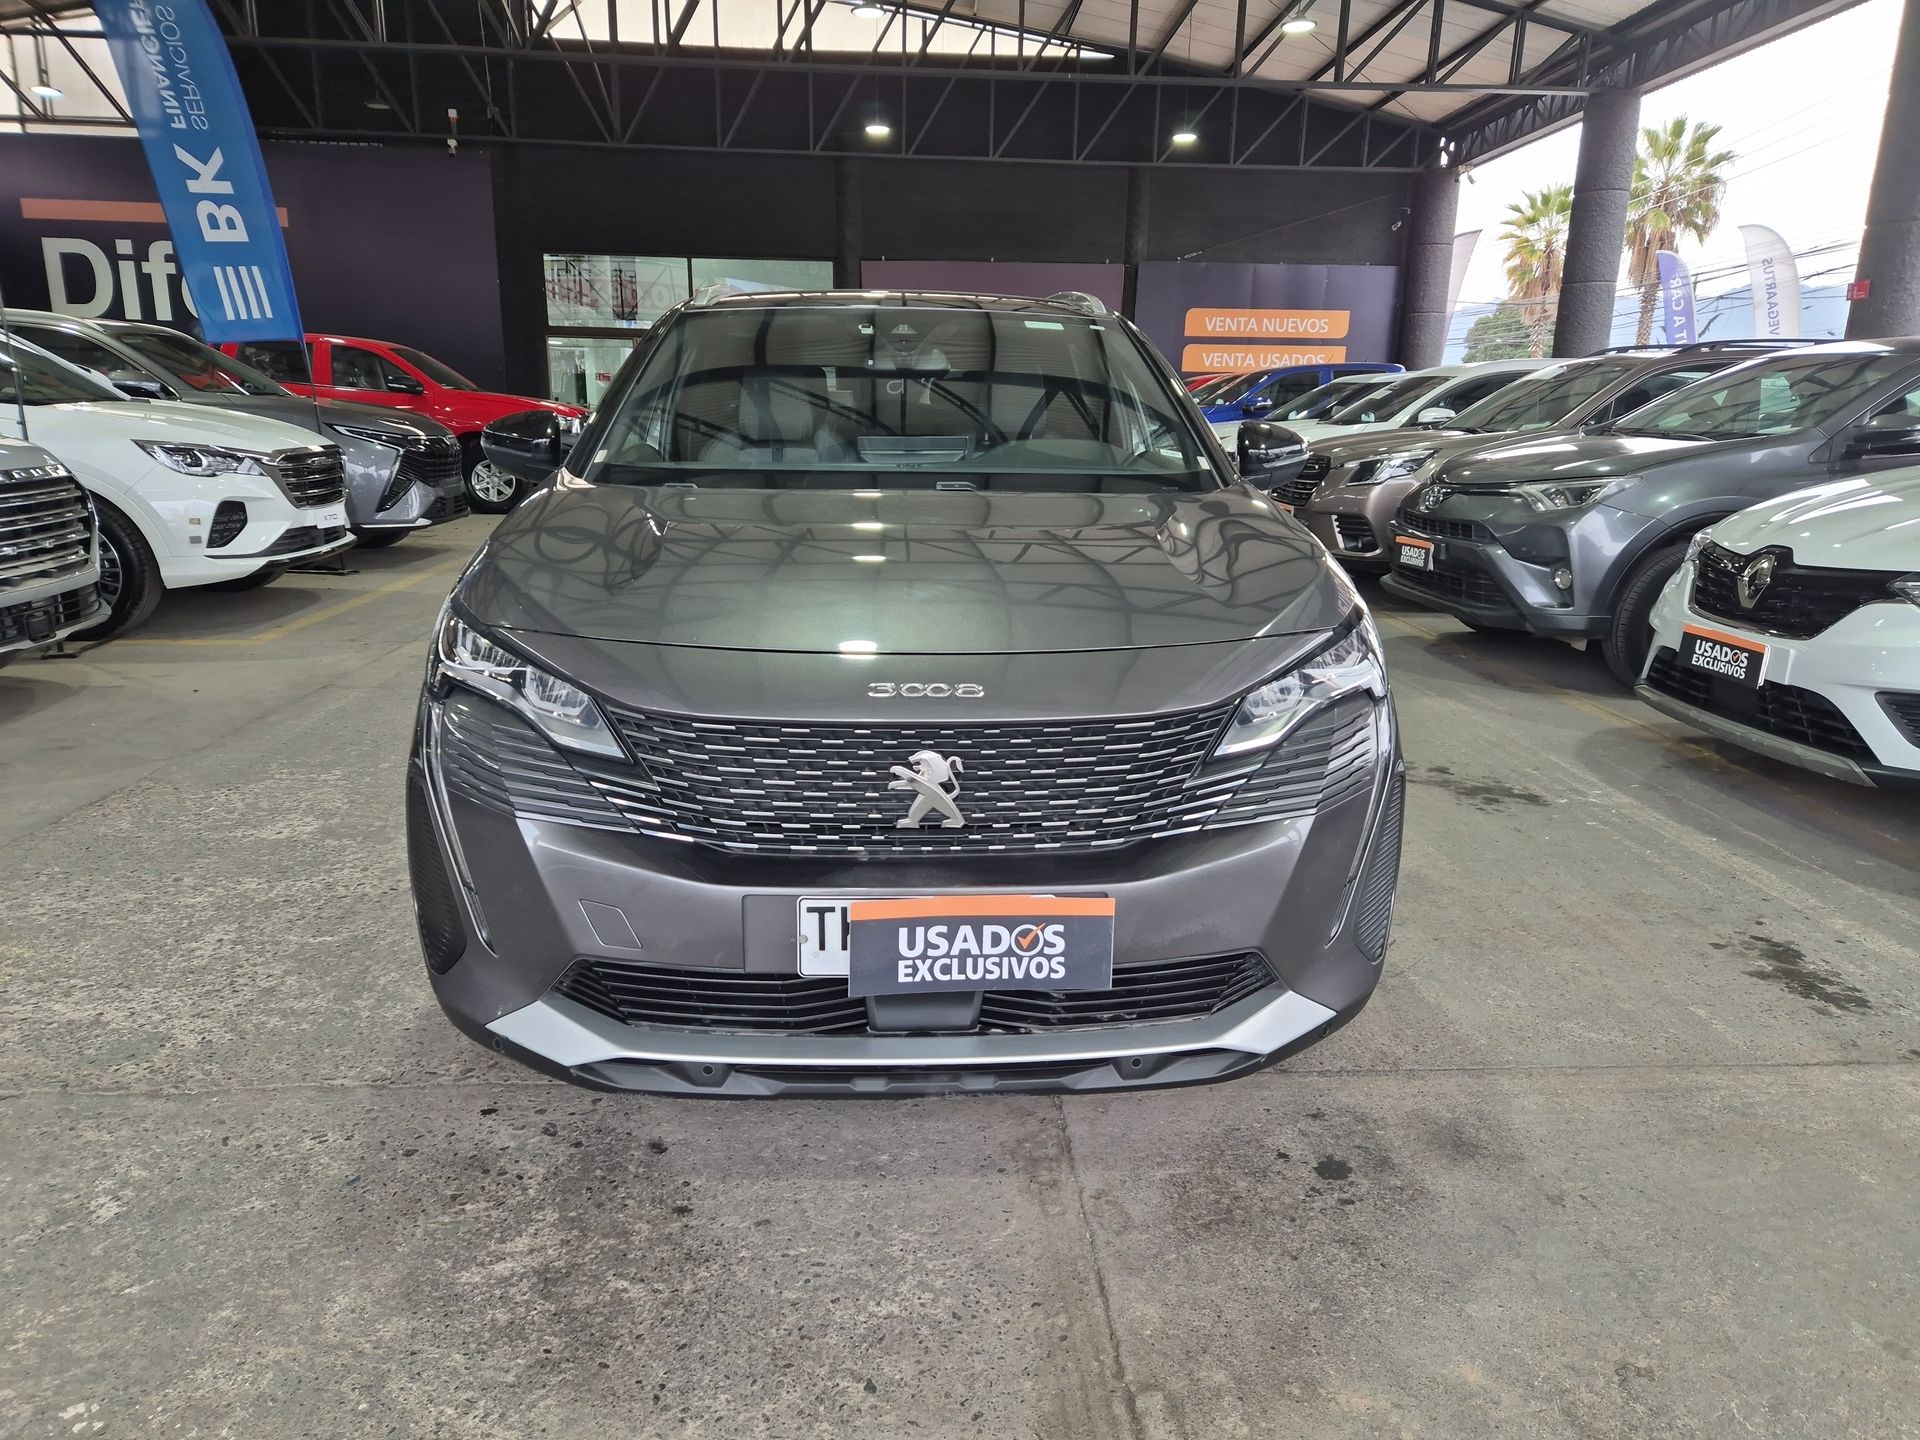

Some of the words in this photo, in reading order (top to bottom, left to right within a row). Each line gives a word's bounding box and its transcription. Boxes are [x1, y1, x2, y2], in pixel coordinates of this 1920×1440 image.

[41, 237, 200, 321] Dif
[1205, 317, 1257, 332] VENTA
[1262, 318, 1329, 333] NUEVOS
[1202, 353, 1255, 367] VENTA
[1260, 353, 1326, 367] USADOS
[1401, 545, 1425, 559] USADOS
[1691, 653, 1746, 679] EXCLUSIVOS
[1695, 639, 1749, 667] USADOS
[867, 682, 984, 698] 3008
[898, 923, 1066, 957] USADOS
[897, 956, 1066, 983] EXCLUSIVOS
